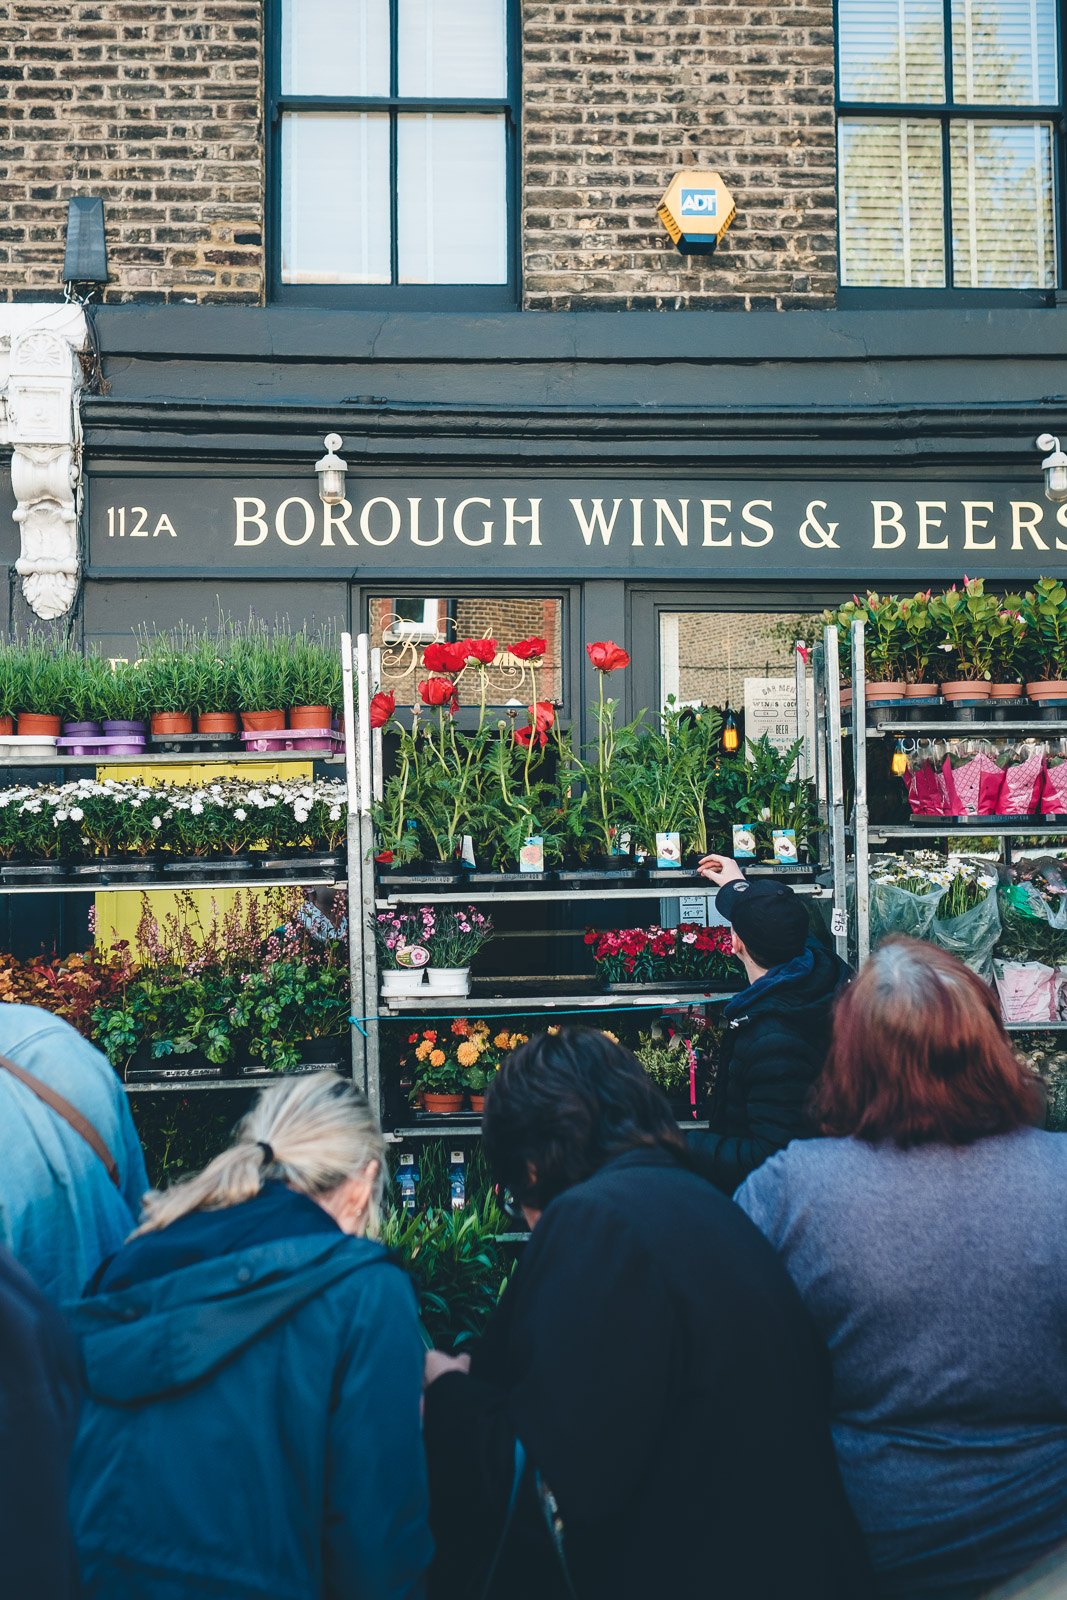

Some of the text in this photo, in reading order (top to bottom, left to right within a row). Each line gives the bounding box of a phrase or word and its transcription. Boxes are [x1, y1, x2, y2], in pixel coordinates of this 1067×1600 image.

[681, 194, 716, 211] ADT
[107, 506, 177, 537] 112A
[233, 496, 543, 546] BOROUGH
[568, 498, 774, 547] WINES
[798, 499, 841, 549] &
[776, 724, 788, 734] BEER
